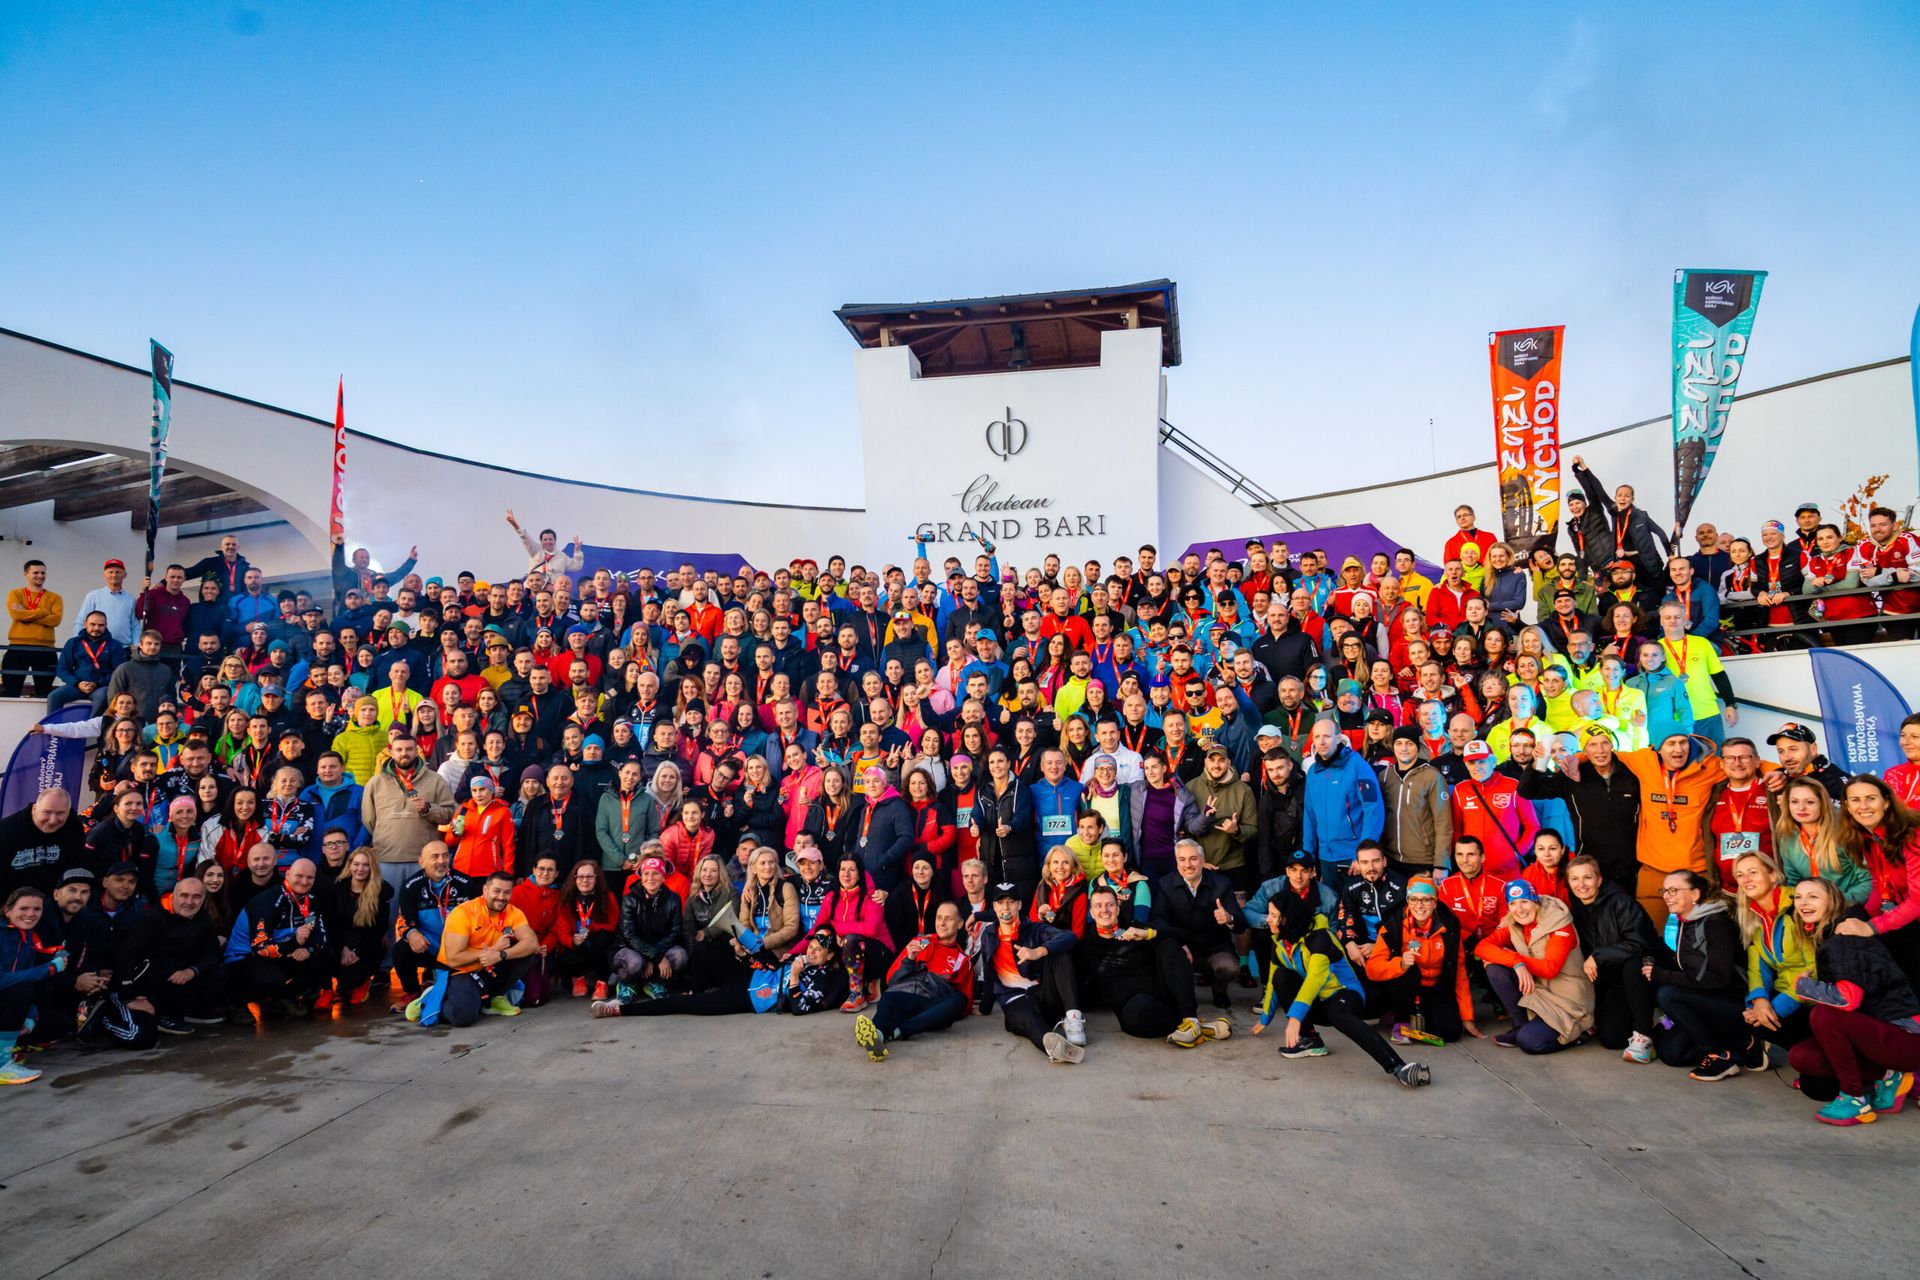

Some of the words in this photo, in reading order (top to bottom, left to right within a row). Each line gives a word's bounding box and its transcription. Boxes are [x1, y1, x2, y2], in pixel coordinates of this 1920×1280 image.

[1528, 380, 1559, 510] VÝCHOD
[952, 473, 1056, 517] Chateau
[916, 519, 1021, 543] GRAND
[1034, 514, 1106, 538] BARI
[45, 735, 58, 789] AMOSPRÁVN
[53, 772, 63, 789] RAJ
[1048, 820, 1067, 829] 17/2
